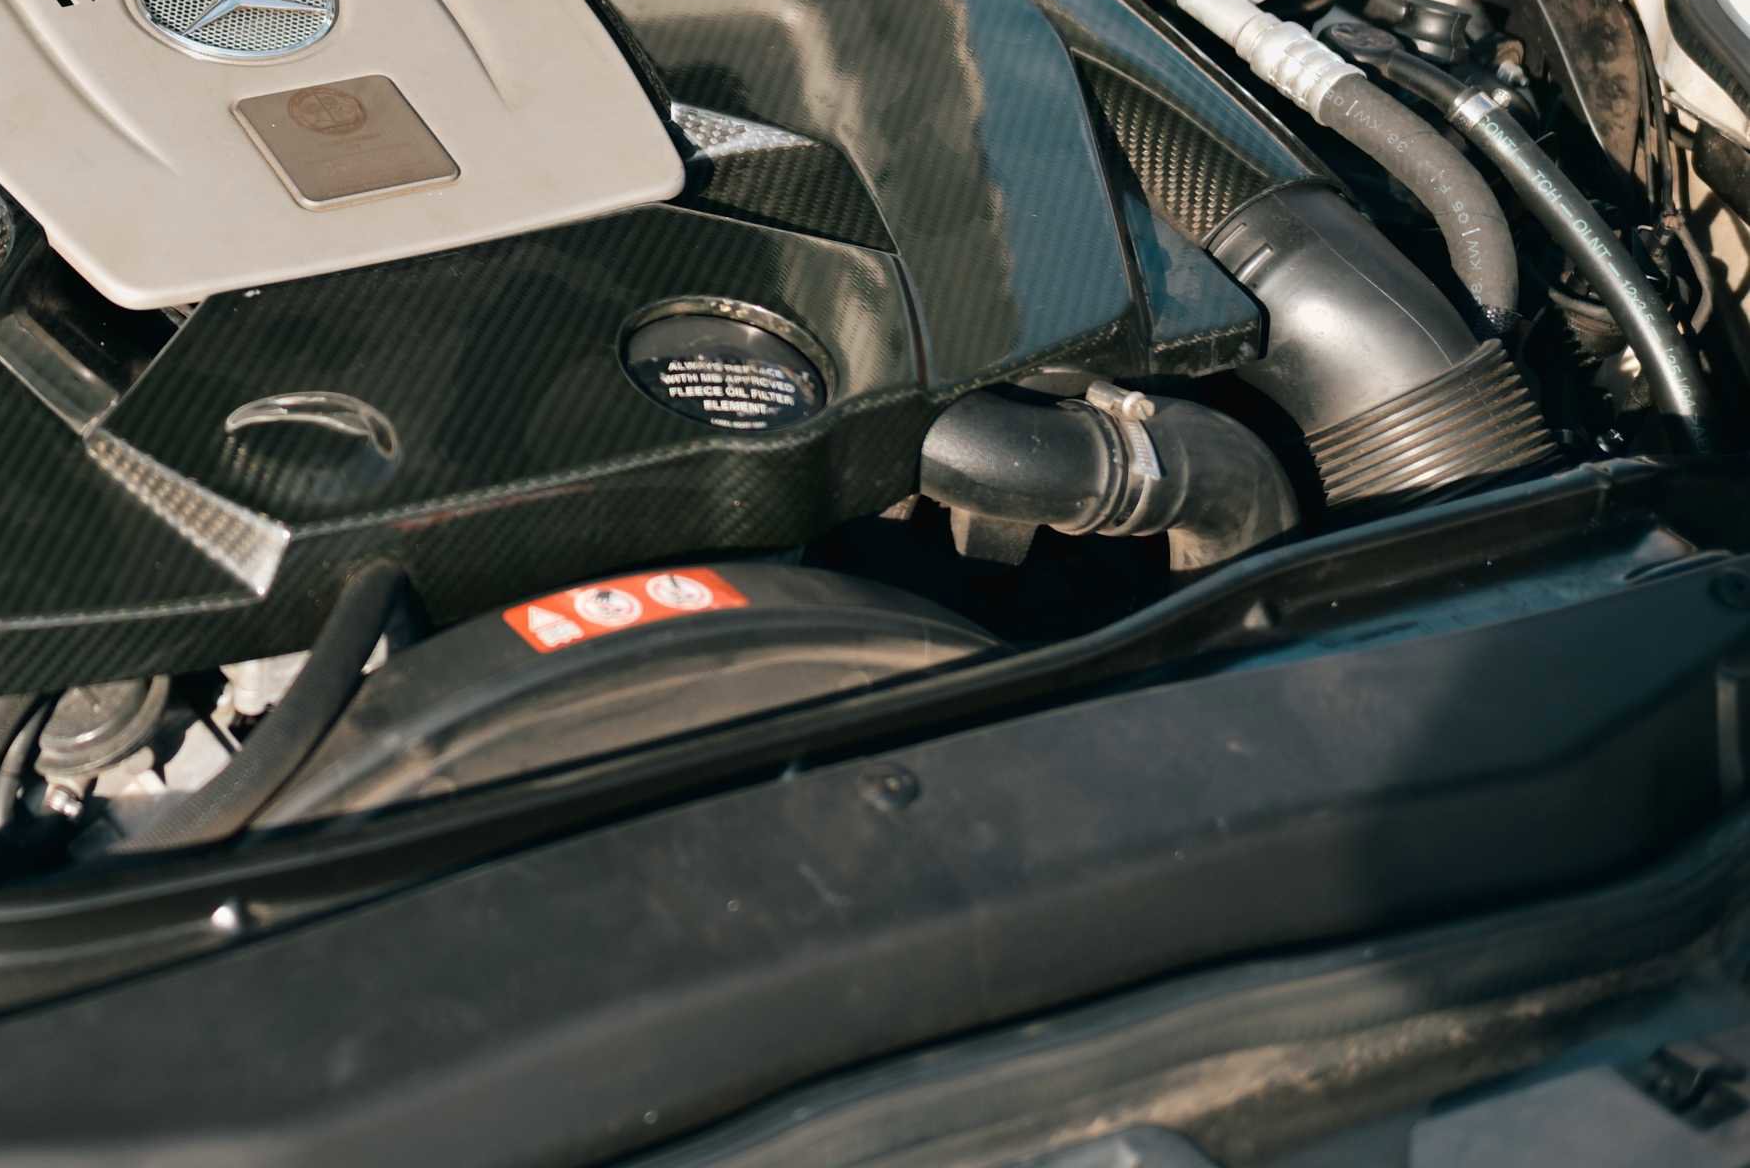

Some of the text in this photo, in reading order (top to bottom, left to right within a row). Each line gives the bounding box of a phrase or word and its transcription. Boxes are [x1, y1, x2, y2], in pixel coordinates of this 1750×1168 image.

[1531, 169, 1562, 202] TCH
[1466, 240, 1483, 270] KW
[668, 361, 723, 372] ALWAYS
[662, 373, 699, 385] WITH
[725, 374, 796, 393] APPROVED
[668, 386, 795, 406] FLEECE OIL FILTER
[703, 399, 768, 415] ELEMENT
